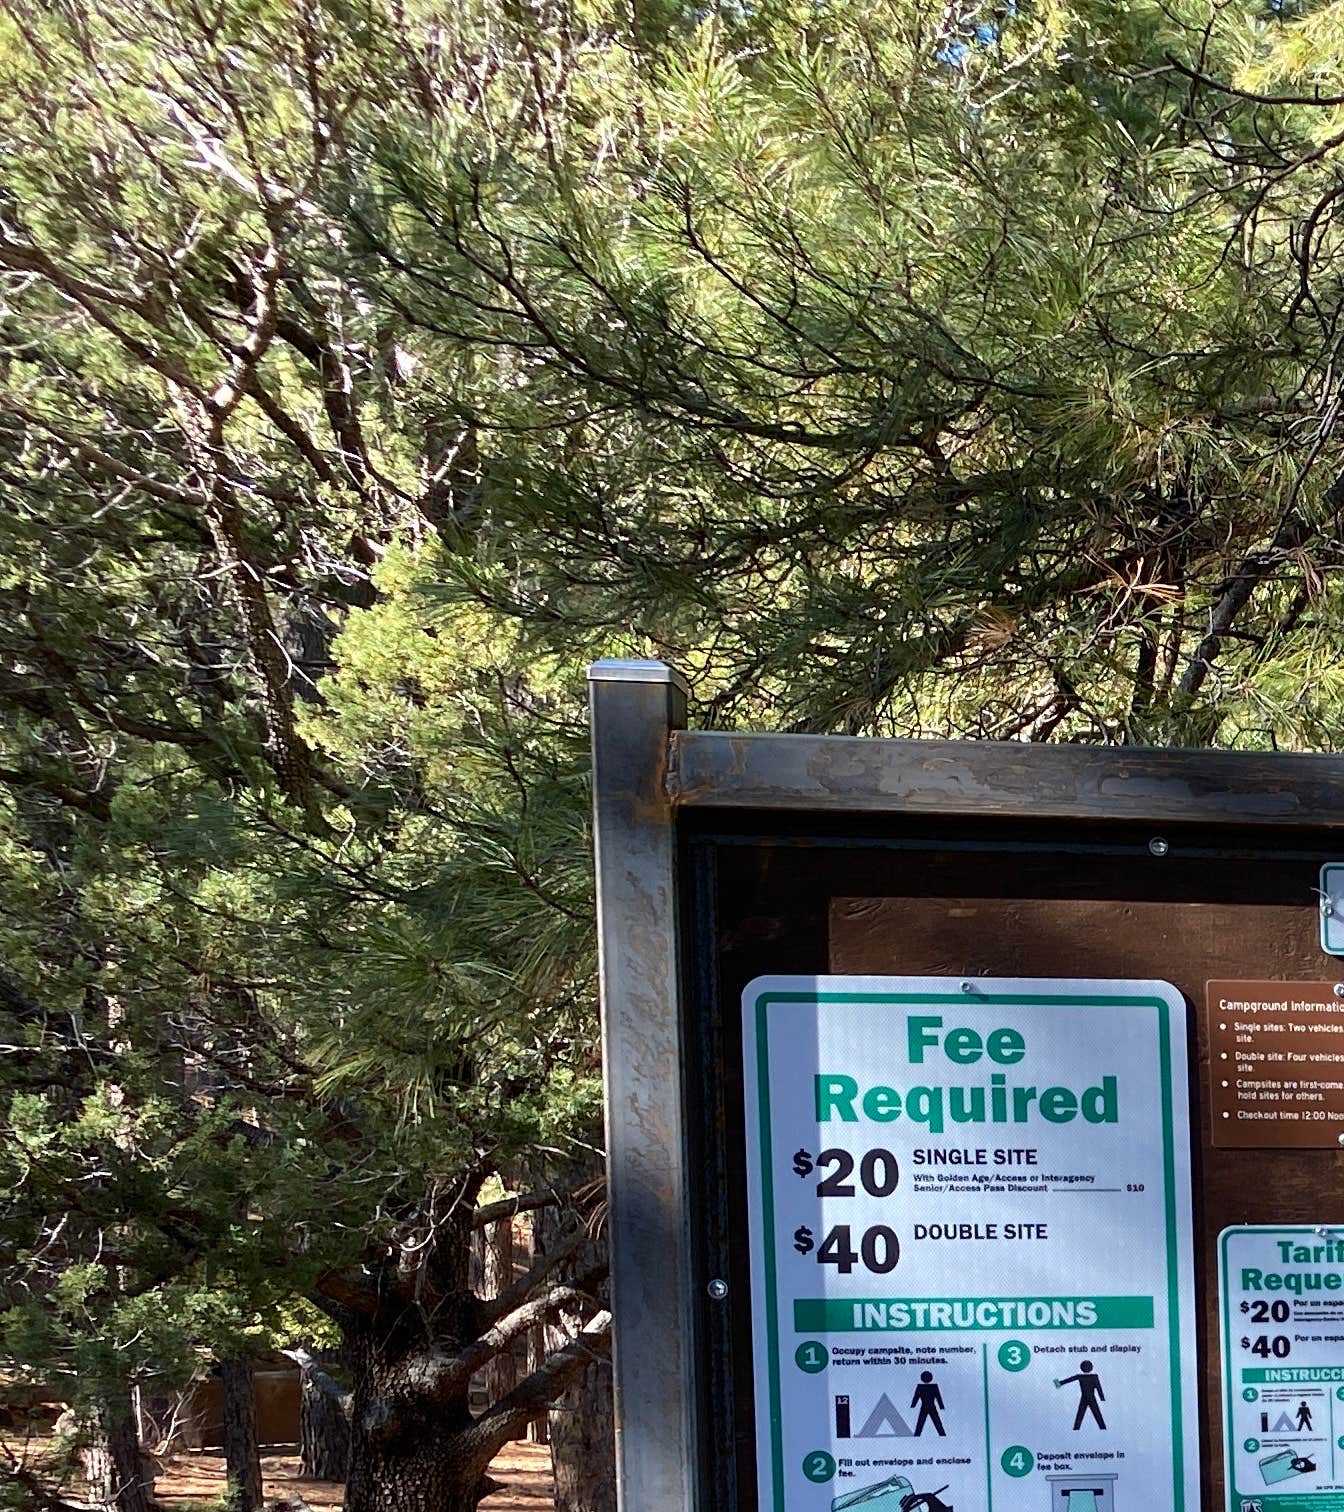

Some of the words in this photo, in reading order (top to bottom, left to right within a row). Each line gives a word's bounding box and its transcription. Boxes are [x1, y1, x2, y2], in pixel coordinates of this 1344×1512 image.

[1219, 999, 1288, 1014] Campground
[1234, 1022, 1262, 1034] Single
[1288, 1023, 1306, 1033] Two
[907, 1015, 1026, 1065] Fee
[1235, 1051, 1265, 1062] Double
[1287, 1052, 1307, 1062] Four
[1236, 1079, 1281, 1090] Campsites
[1284, 1081, 1298, 1089] are
[1238, 1091, 1257, 1101] hold
[1259, 1091, 1279, 1101] sites
[1281, 1091, 1293, 1101] for
[814, 1074, 1119, 1134] Required
[1237, 1110, 1278, 1120] Checkout
[1280, 1111, 1299, 1120] time
[1301, 1111, 1326, 1121] 12:00
[913, 1149, 987, 1166] SINGLE
[993, 1149, 1038, 1165] SITE
[792, 1148, 899, 1198] $20
[913, 1174, 935, 1183] With
[937, 1174, 969, 1183] Golden
[972, 1173, 1027, 1184] Age/Access
[1041, 1174, 1095, 1184] Interagency
[913, 1184, 981, 1193] Senior/Access
[983, 1184, 1006, 1193] Pass
[1007, 1184, 1048, 1193] Discount
[1126, 1184, 1145, 1193] $10
[914, 1223, 998, 1240] DOUBLE
[1003, 1223, 1048, 1240] SITE
[793, 1224, 900, 1274] $40
[1294, 1299, 1307, 1307] Por
[852, 1300, 1099, 1329] INSTRUCTIONS
[1240, 1300, 1290, 1323] $20
[1294, 1334, 1309, 1342] Por
[832, 1346, 866, 1356] Occupy
[868, 1346, 914, 1355] campsite,
[916, 1346, 936, 1354] note
[938, 1345, 976, 1354] number,
[1033, 1345, 1066, 1354] Detach
[1068, 1345, 1088, 1353] stub
[1110, 1344, 1141, 1354] display
[1240, 1336, 1291, 1358] $40
[805, 1347, 821, 1365] 1
[1007, 1346, 1022, 1365] 3
[832, 1358, 861, 1366] return
[863, 1357, 891, 1365] within
[894, 1357, 907, 1365] 30
[909, 1357, 948, 1365] minutes.
[1010, 1452, 1025, 1470] 4
[1037, 1452, 1072, 1461] Deposit
[1074, 1451, 1114, 1460] envelope
[812, 1457, 827, 1476] 2
[839, 1458, 853, 1467] Fill
[855, 1459, 870, 1467] out
[872, 1458, 914, 1467] envelope
[916, 1457, 933, 1465] and
[935, 1457, 972, 1465] enclose
[1037, 1463, 1052, 1471] fee
[1054, 1462, 1072, 1471] box.
[839, 1469, 856, 1477] fee.
